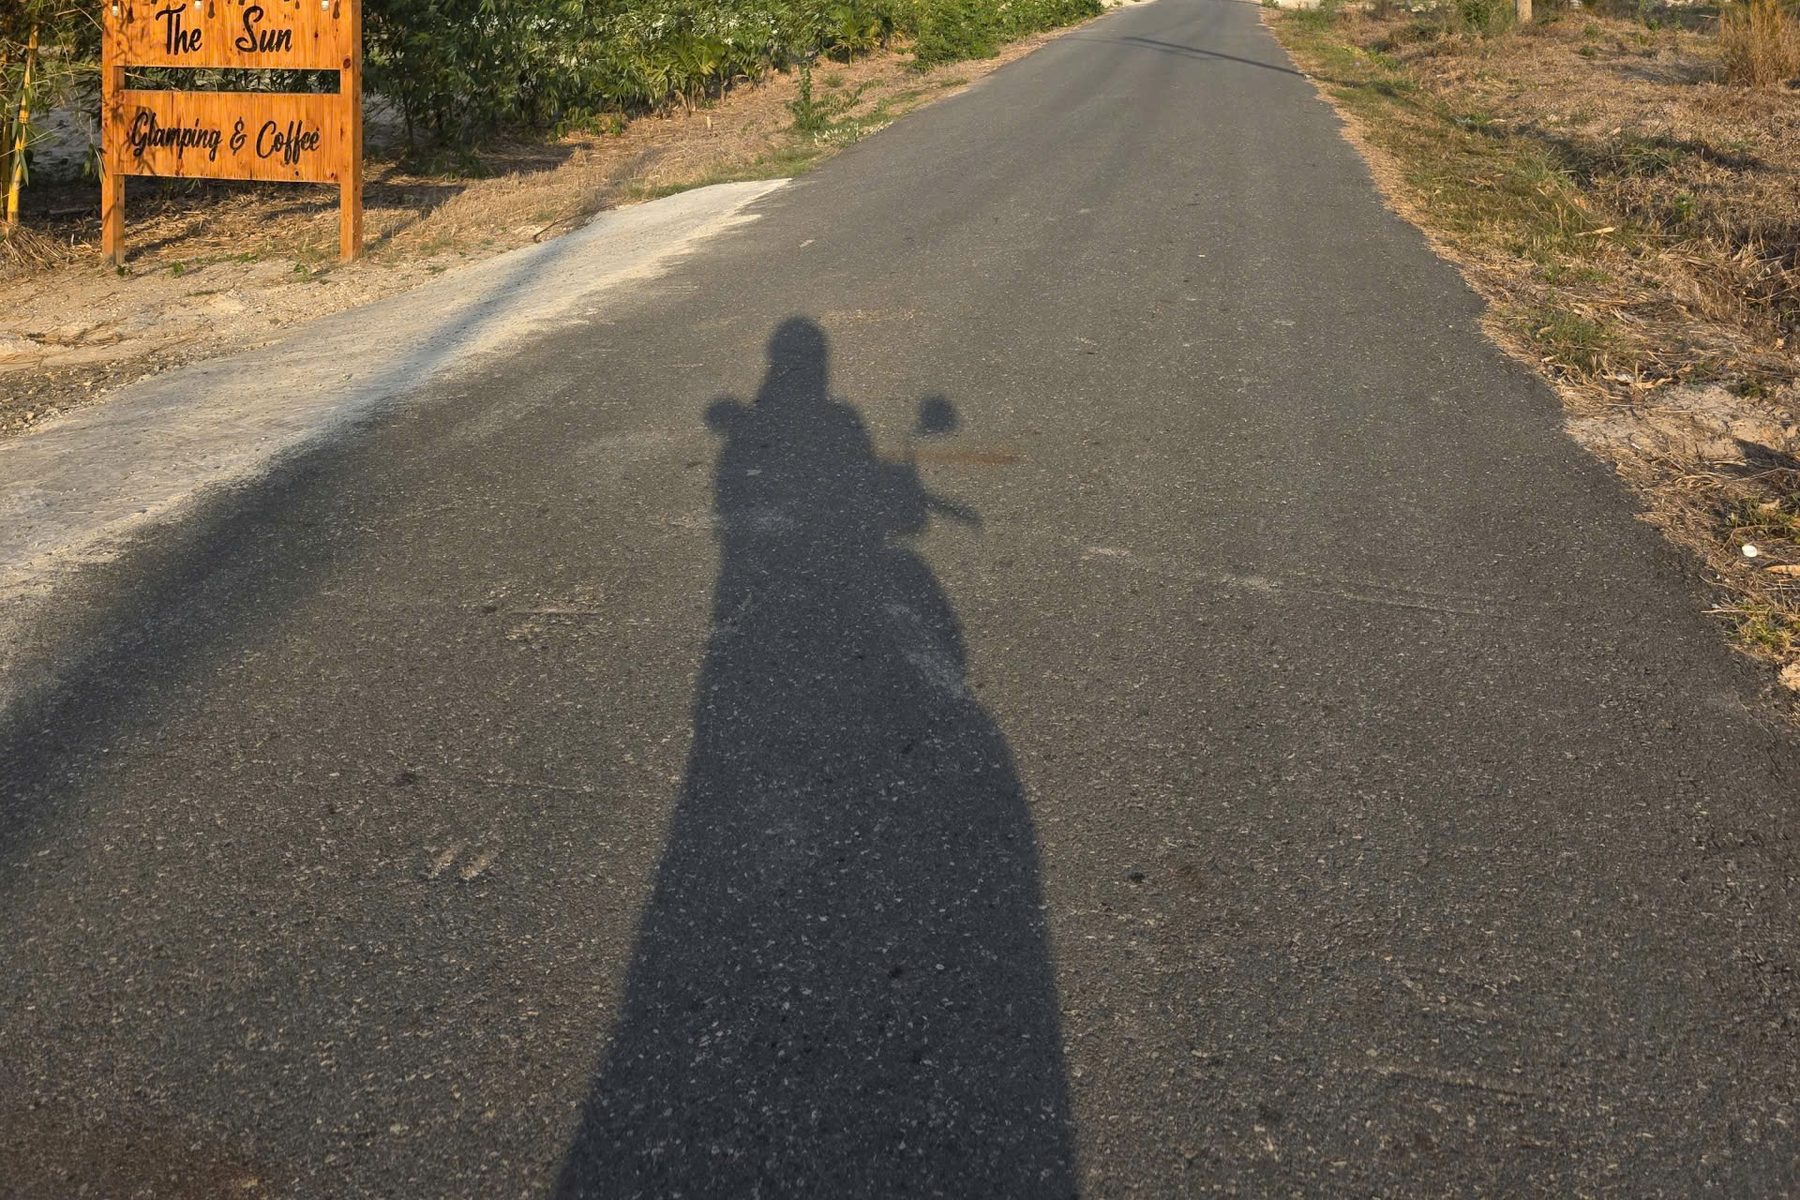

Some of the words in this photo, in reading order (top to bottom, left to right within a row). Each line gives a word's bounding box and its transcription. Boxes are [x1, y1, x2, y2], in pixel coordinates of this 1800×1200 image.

[156, 4, 203, 55] The
[235, 5, 292, 53] Sun
[131, 111, 223, 162] Glamping
[229, 117, 247, 156] &
[256, 120, 320, 165] Coffee
